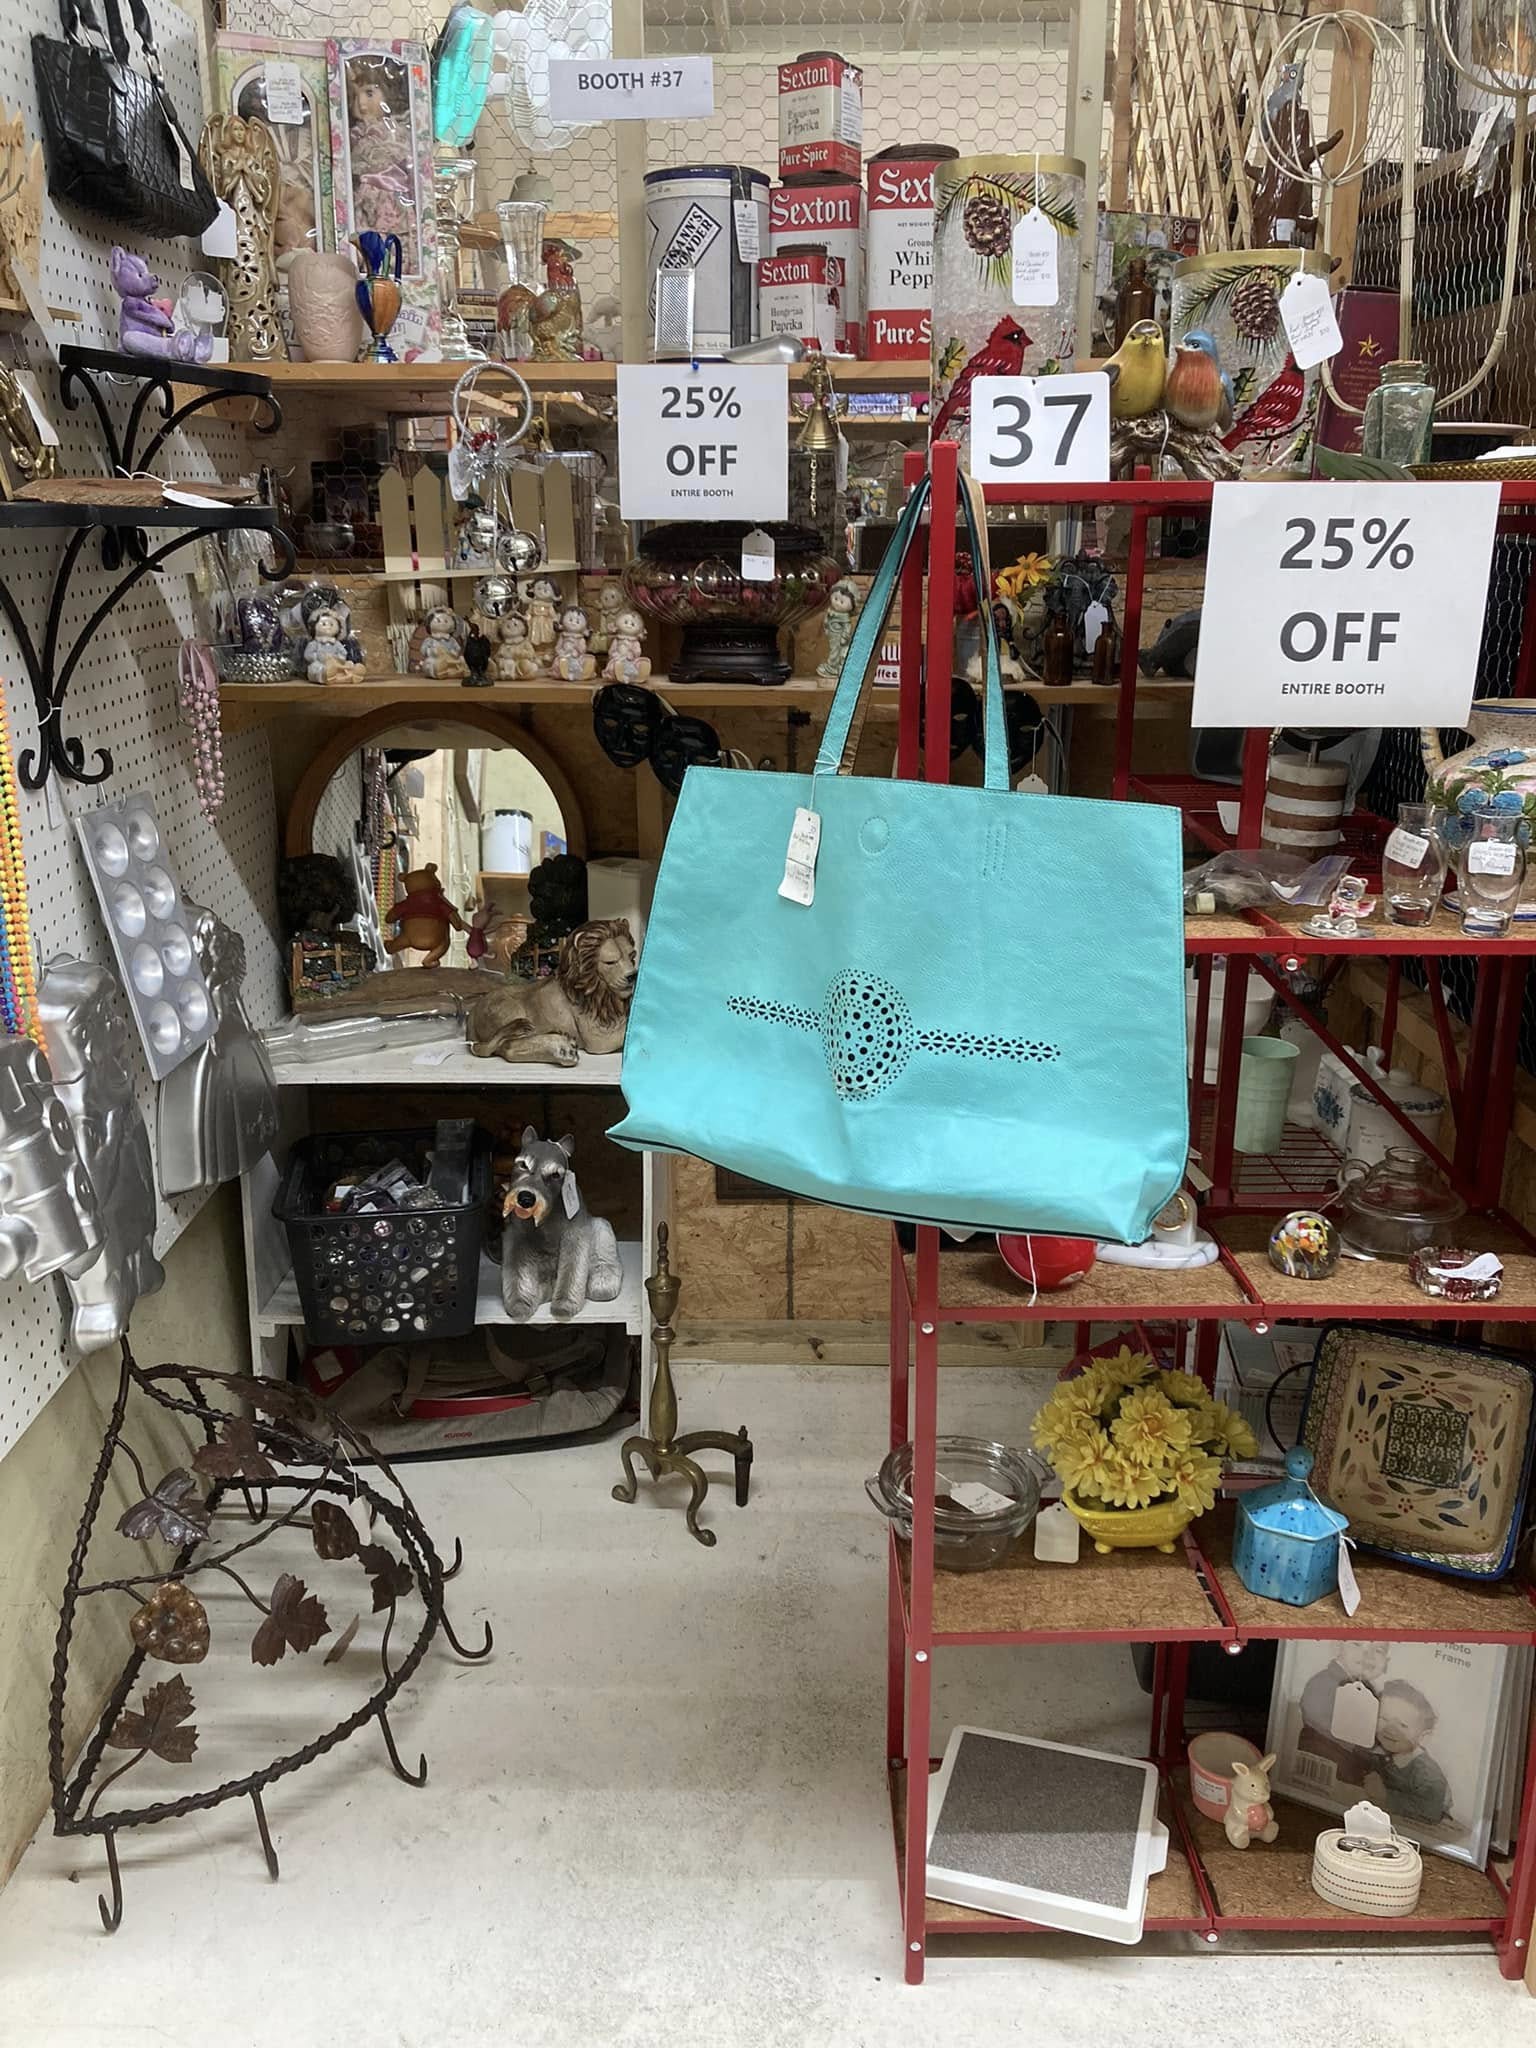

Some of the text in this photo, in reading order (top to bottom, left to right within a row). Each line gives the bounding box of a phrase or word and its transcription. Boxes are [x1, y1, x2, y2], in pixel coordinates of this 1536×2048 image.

[578, 70, 683, 90] BOOTH #37
[780, 66, 828, 90] Sexton
[780, 144, 829, 168] Pure Spice
[771, 194, 852, 227] Sexton
[761, 261, 810, 284] Sexton
[873, 319, 914, 345] Pure
[661, 386, 742, 418] 25%
[989, 394, 1093, 468] 37
[666, 444, 738, 476] OFF
[671, 489, 734, 497] ENTIRE BOOTH
[1279, 518, 1414, 570] 25%
[1279, 611, 1401, 662] OFF
[1281, 683, 1385, 695] ENTIRE BOOTH
[1434, 1649, 1471, 1668] Frame
